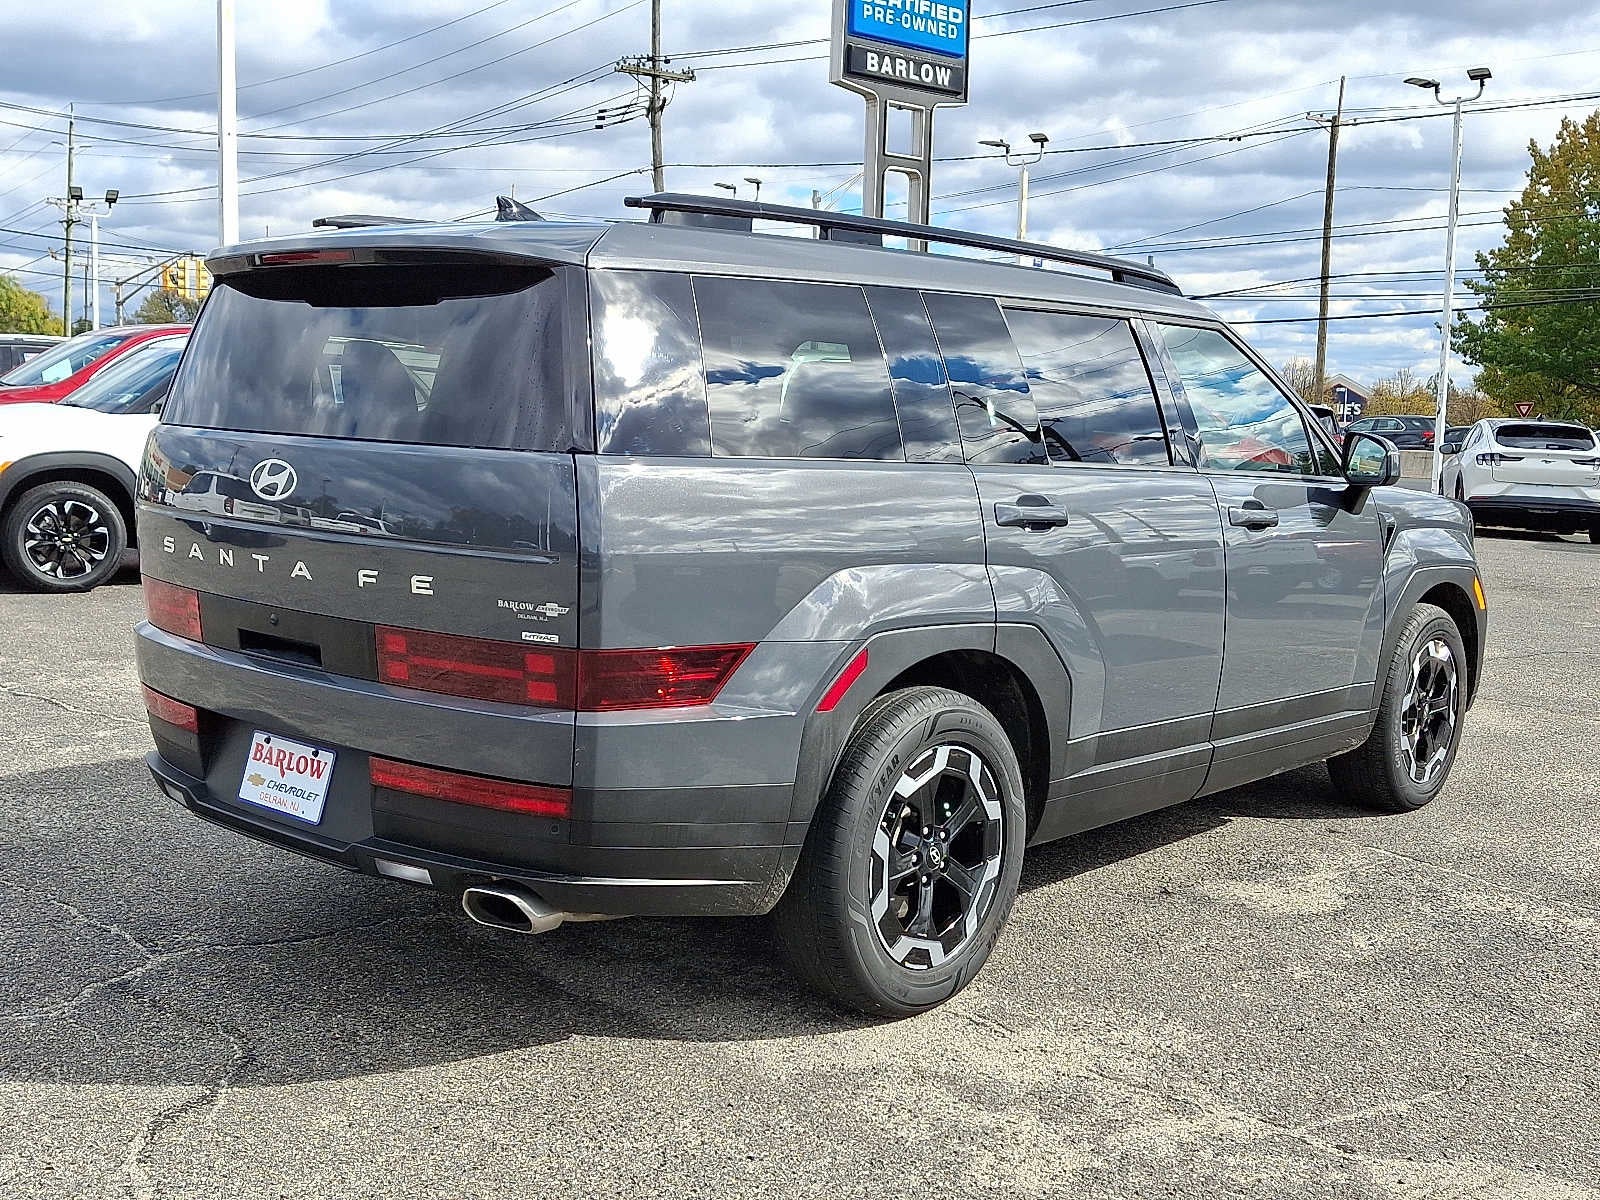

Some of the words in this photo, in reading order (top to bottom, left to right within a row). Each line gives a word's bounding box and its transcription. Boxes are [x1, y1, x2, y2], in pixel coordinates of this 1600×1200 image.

[861, 0, 963, 24] RTIFIED
[863, 4, 958, 39] PRE-OWNED
[866, 51, 951, 87] BARLOW
[163, 536, 312, 581] SANTA
[357, 569, 433, 596] FE
[497, 600, 534, 612] BARLOW
[252, 742, 328, 779] BARLOW
[266, 780, 320, 803] CHEVROLET
[290, 801, 300, 812] NJ
